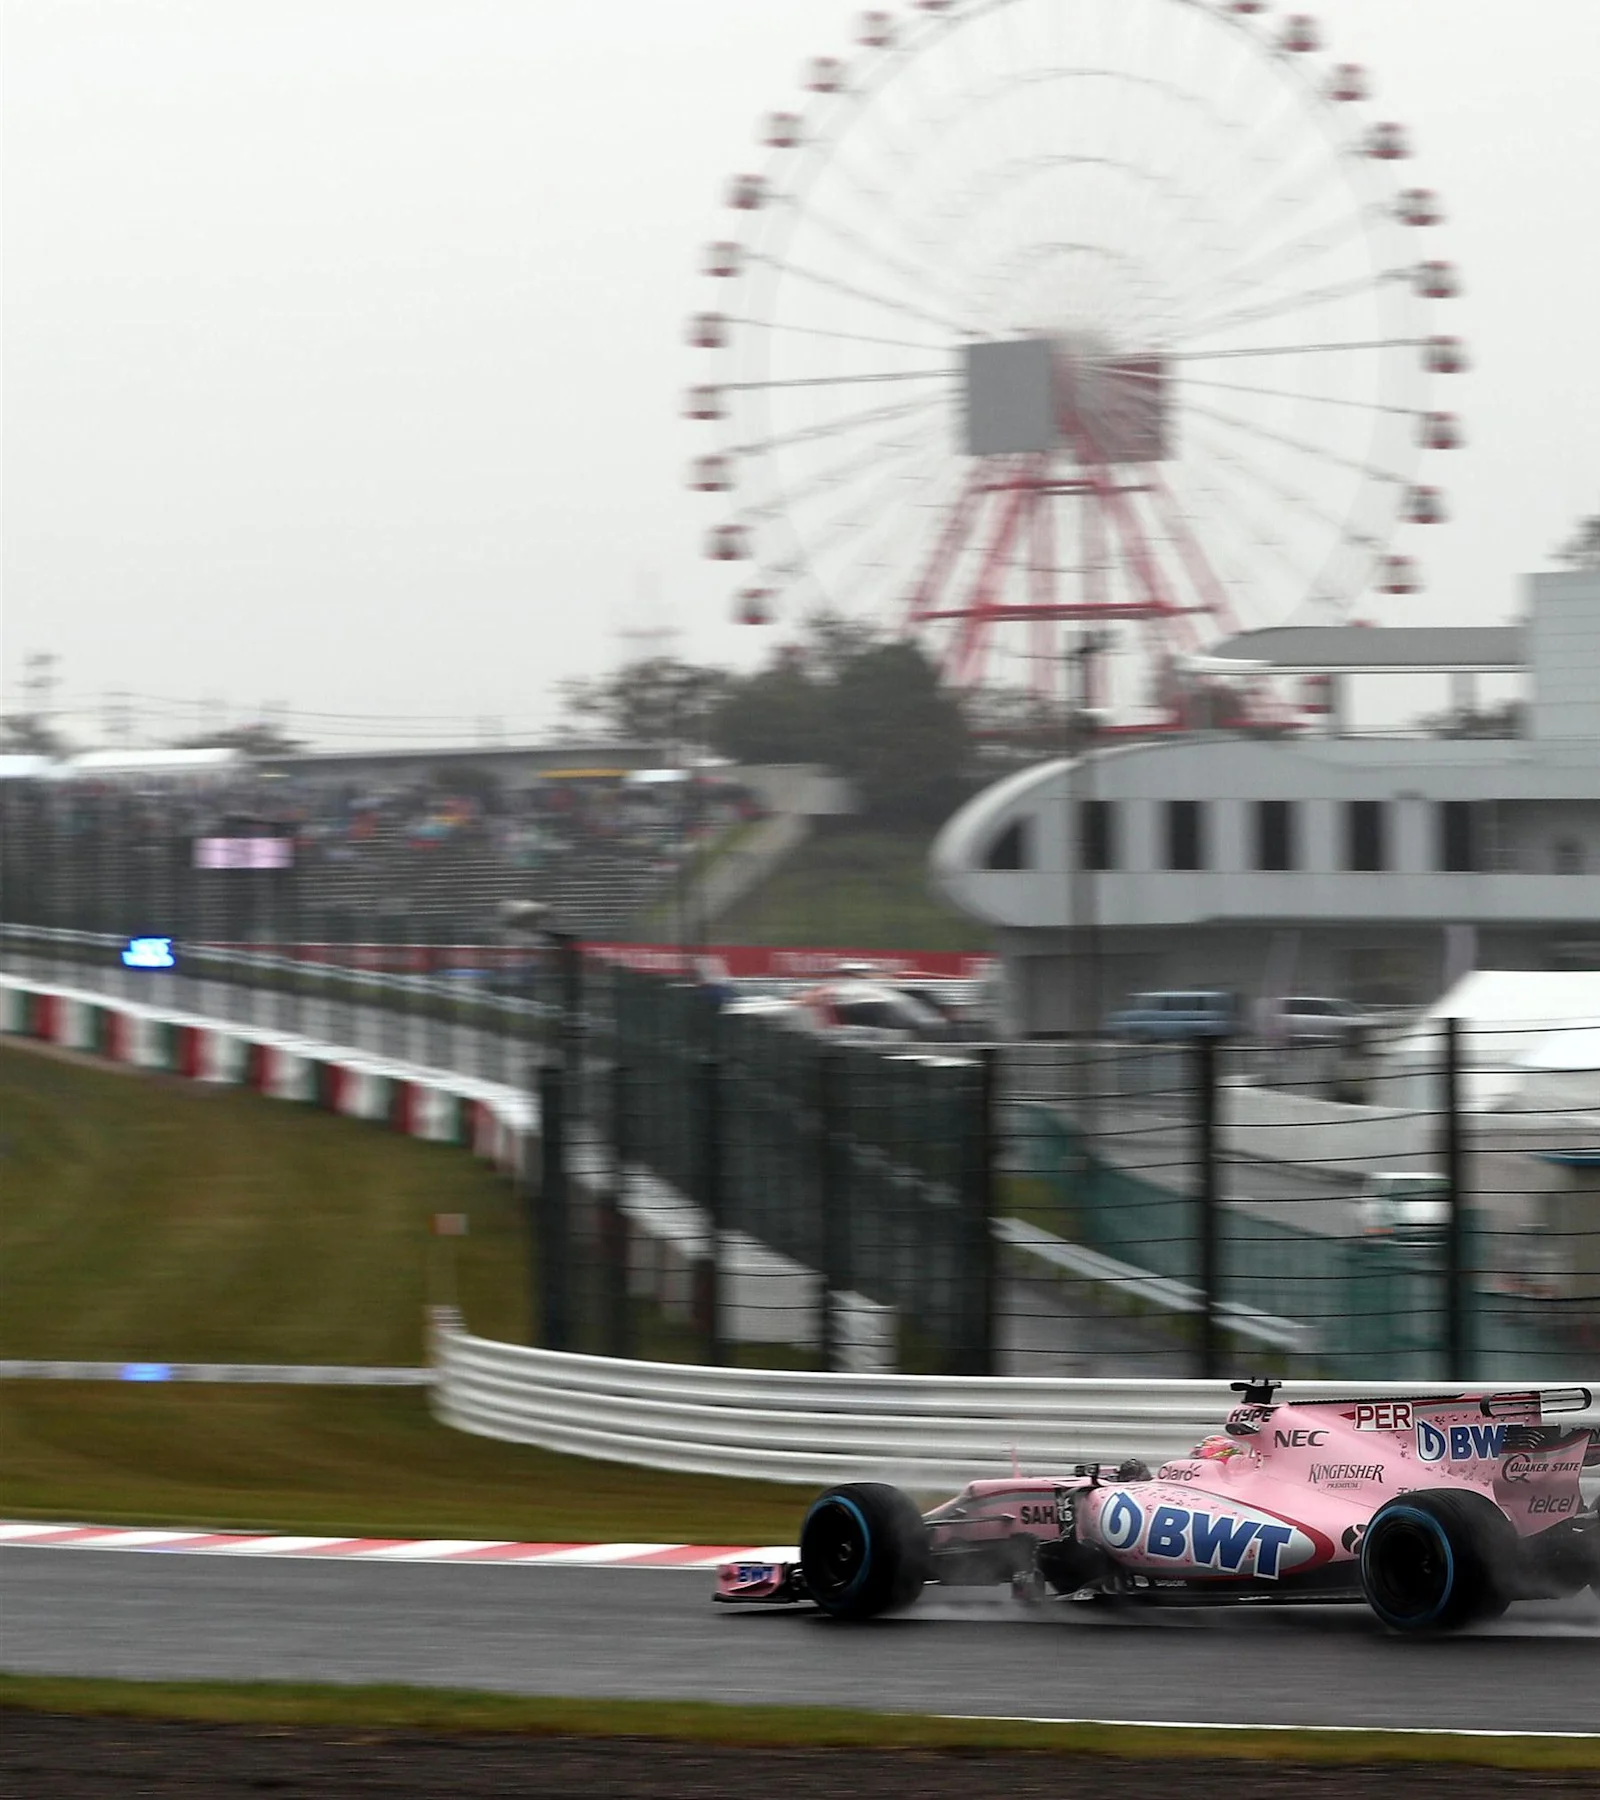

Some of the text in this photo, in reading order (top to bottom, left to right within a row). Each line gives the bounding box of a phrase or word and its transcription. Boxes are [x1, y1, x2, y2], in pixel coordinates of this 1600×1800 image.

[1229, 1408, 1274, 1423] HYPE
[1356, 1405, 1412, 1429] PER
[1275, 1430, 1330, 1448] NEC
[1450, 1423, 1524, 1461] BW
[1158, 1464, 1196, 1482] Claro
[1308, 1463, 1385, 1484] KINGFISHER
[1551, 1462, 1580, 1472] STATE
[1527, 1494, 1575, 1514] telcel
[1020, 1505, 1060, 1525] SAH
[1147, 1506, 1295, 1580] BWT
